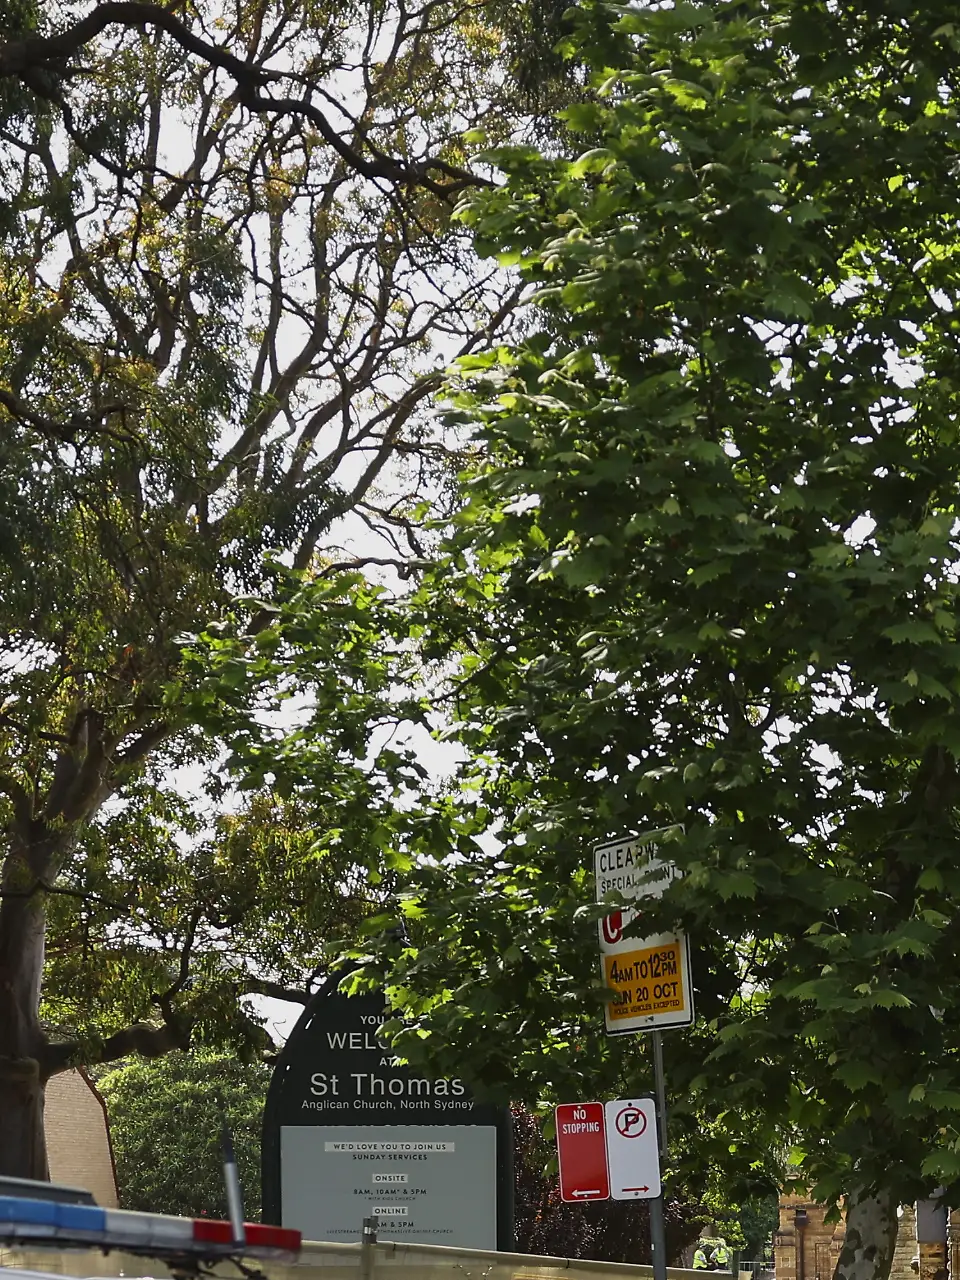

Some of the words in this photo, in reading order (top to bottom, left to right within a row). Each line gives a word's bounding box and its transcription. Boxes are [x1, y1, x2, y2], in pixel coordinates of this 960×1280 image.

[633, 961, 649, 979] TO
[636, 986, 649, 1002] 20
[653, 981, 678, 999] OCT
[653, 999, 680, 1010] EXCEPTED
[360, 1015, 385, 1025] YOU
[310, 1072, 339, 1096] St
[350, 1073, 465, 1096] Thomas
[301, 1099, 349, 1110] Anglican
[353, 1099, 396, 1110] Church,
[400, 1099, 431, 1109] North
[434, 1099, 474, 1110] Sydney
[573, 1109, 587, 1120] NO
[562, 1121, 600, 1135] STOPPING
